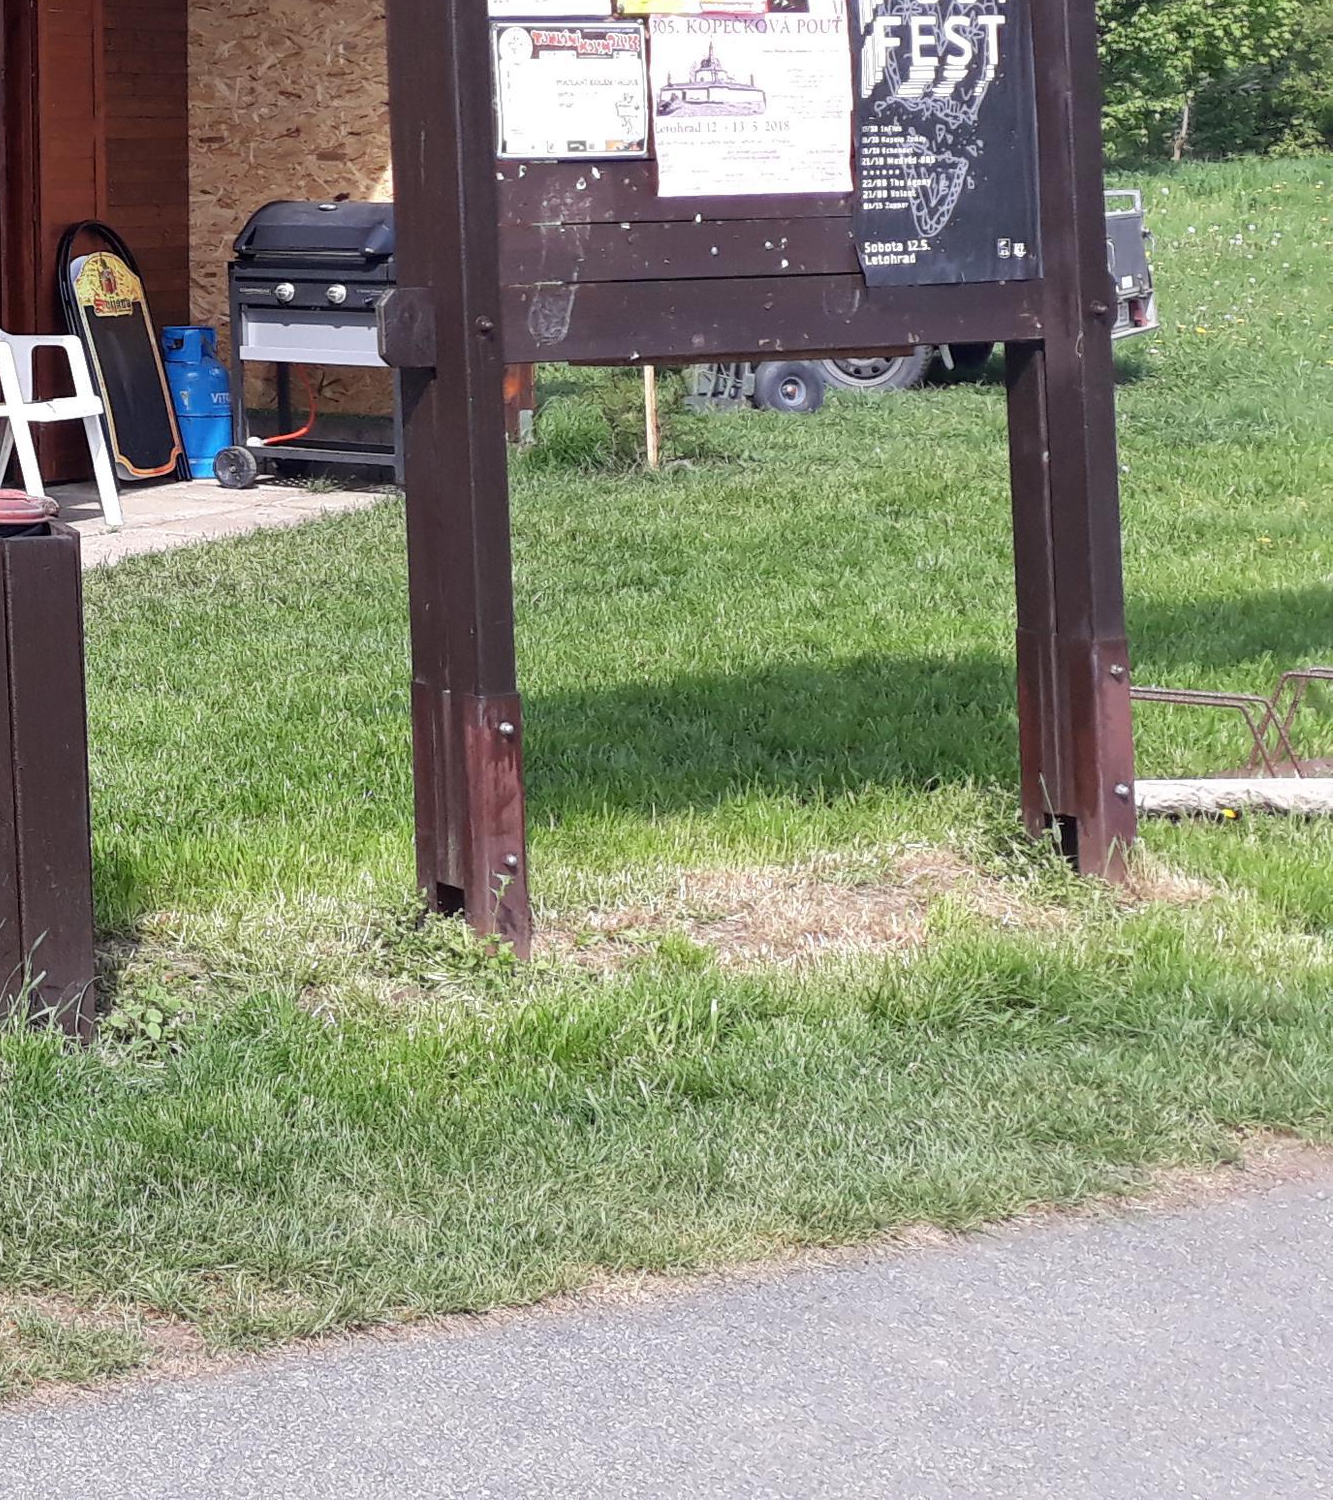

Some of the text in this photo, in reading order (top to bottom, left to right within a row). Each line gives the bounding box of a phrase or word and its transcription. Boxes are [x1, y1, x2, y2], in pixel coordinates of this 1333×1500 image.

[875, 15, 1006, 67] FEST
[864, 241, 904, 254] Sobota
[864, 253, 916, 266] Letohrad
